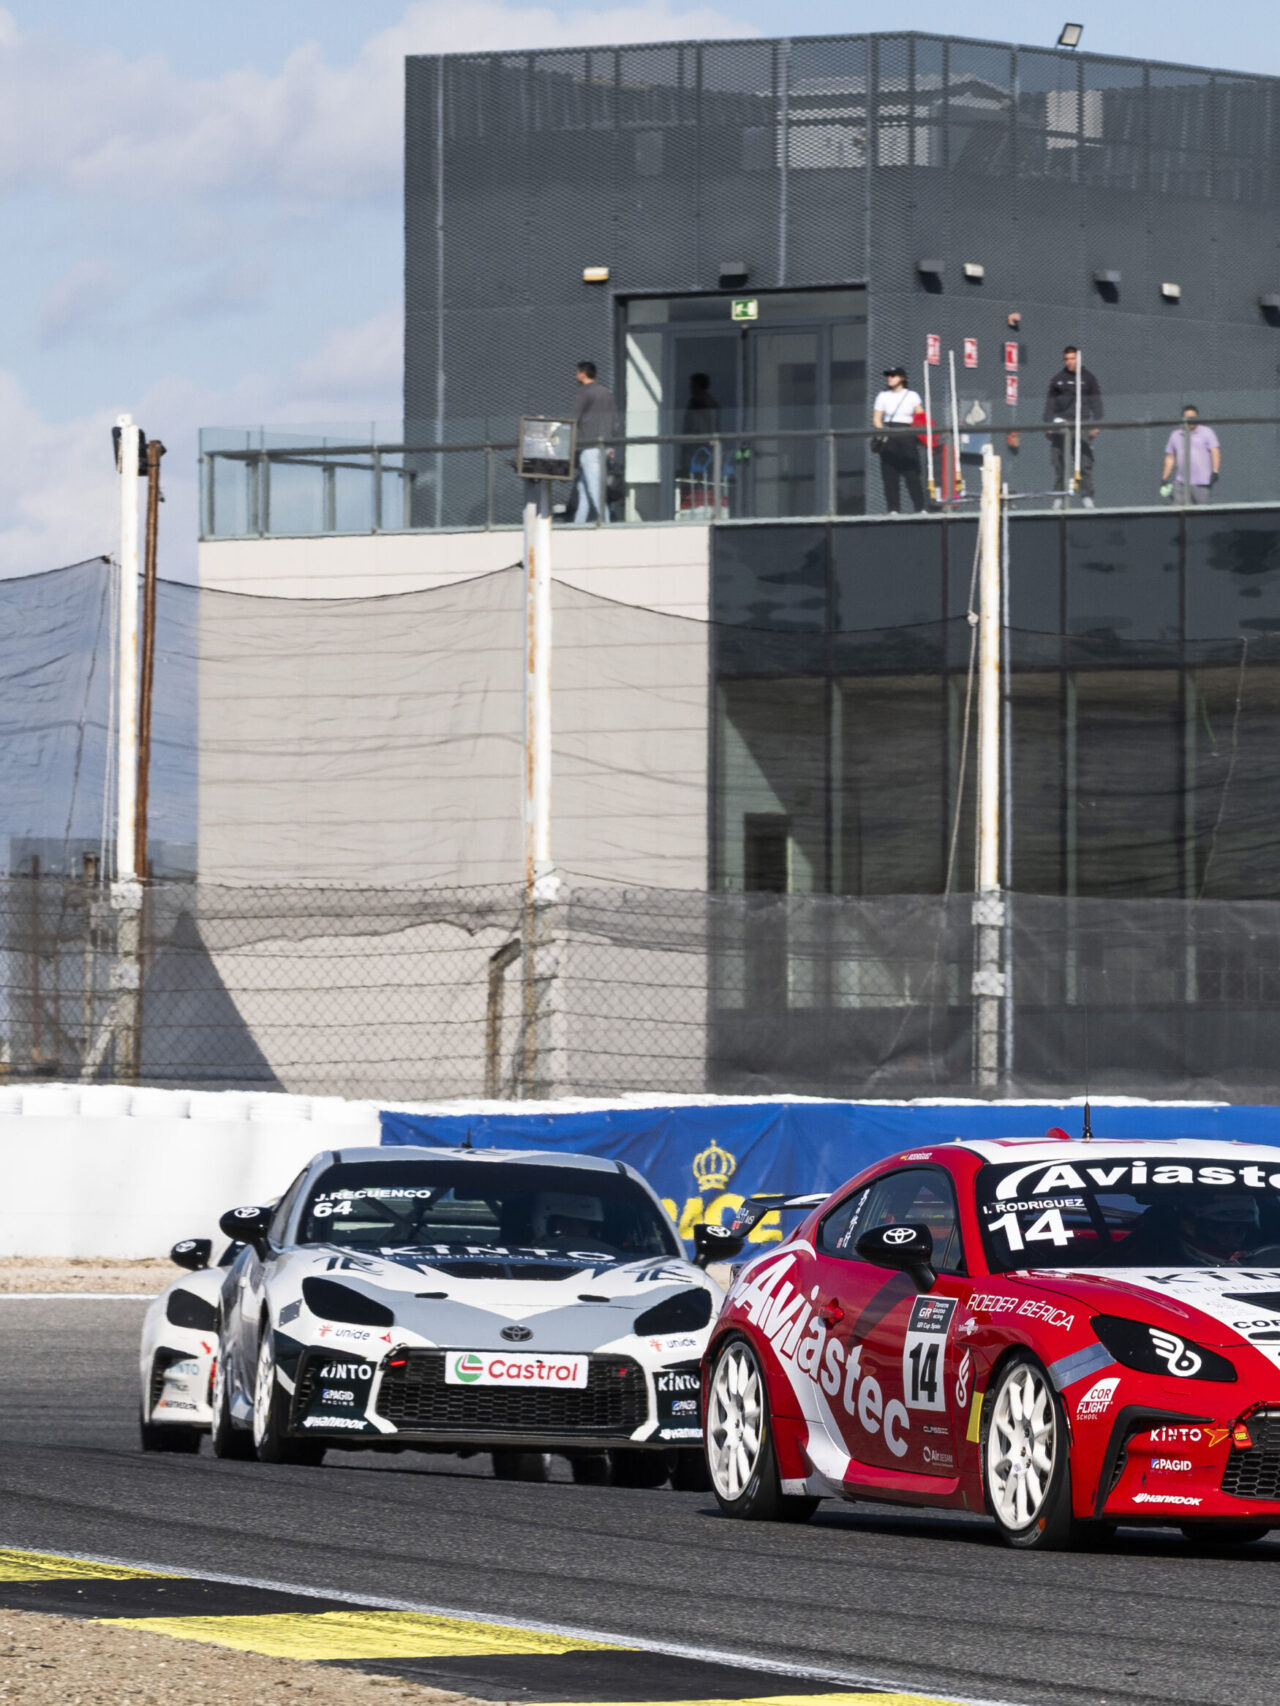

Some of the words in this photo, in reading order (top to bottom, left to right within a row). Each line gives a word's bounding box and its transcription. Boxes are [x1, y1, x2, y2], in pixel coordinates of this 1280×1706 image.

[313, 1200, 352, 1218] 64
[982, 1205, 992, 1215] I.
[996, 1199, 1085, 1213] RODRIGUEZ
[987, 1209, 1075, 1251] 14
[966, 1293, 1019, 1312] ROEDER
[1016, 1300, 1075, 1331] IBÉRICA
[335, 1327, 371, 1340] unide
[734, 1253, 910, 1457] Aviastec
[488, 1359, 578, 1381] Castrol
[909, 1342, 940, 1403] 14
[1090, 1389, 1112, 1400] COR
[1076, 1401, 1110, 1413] FLIGHT
[1160, 1459, 1192, 1471] PAGID
